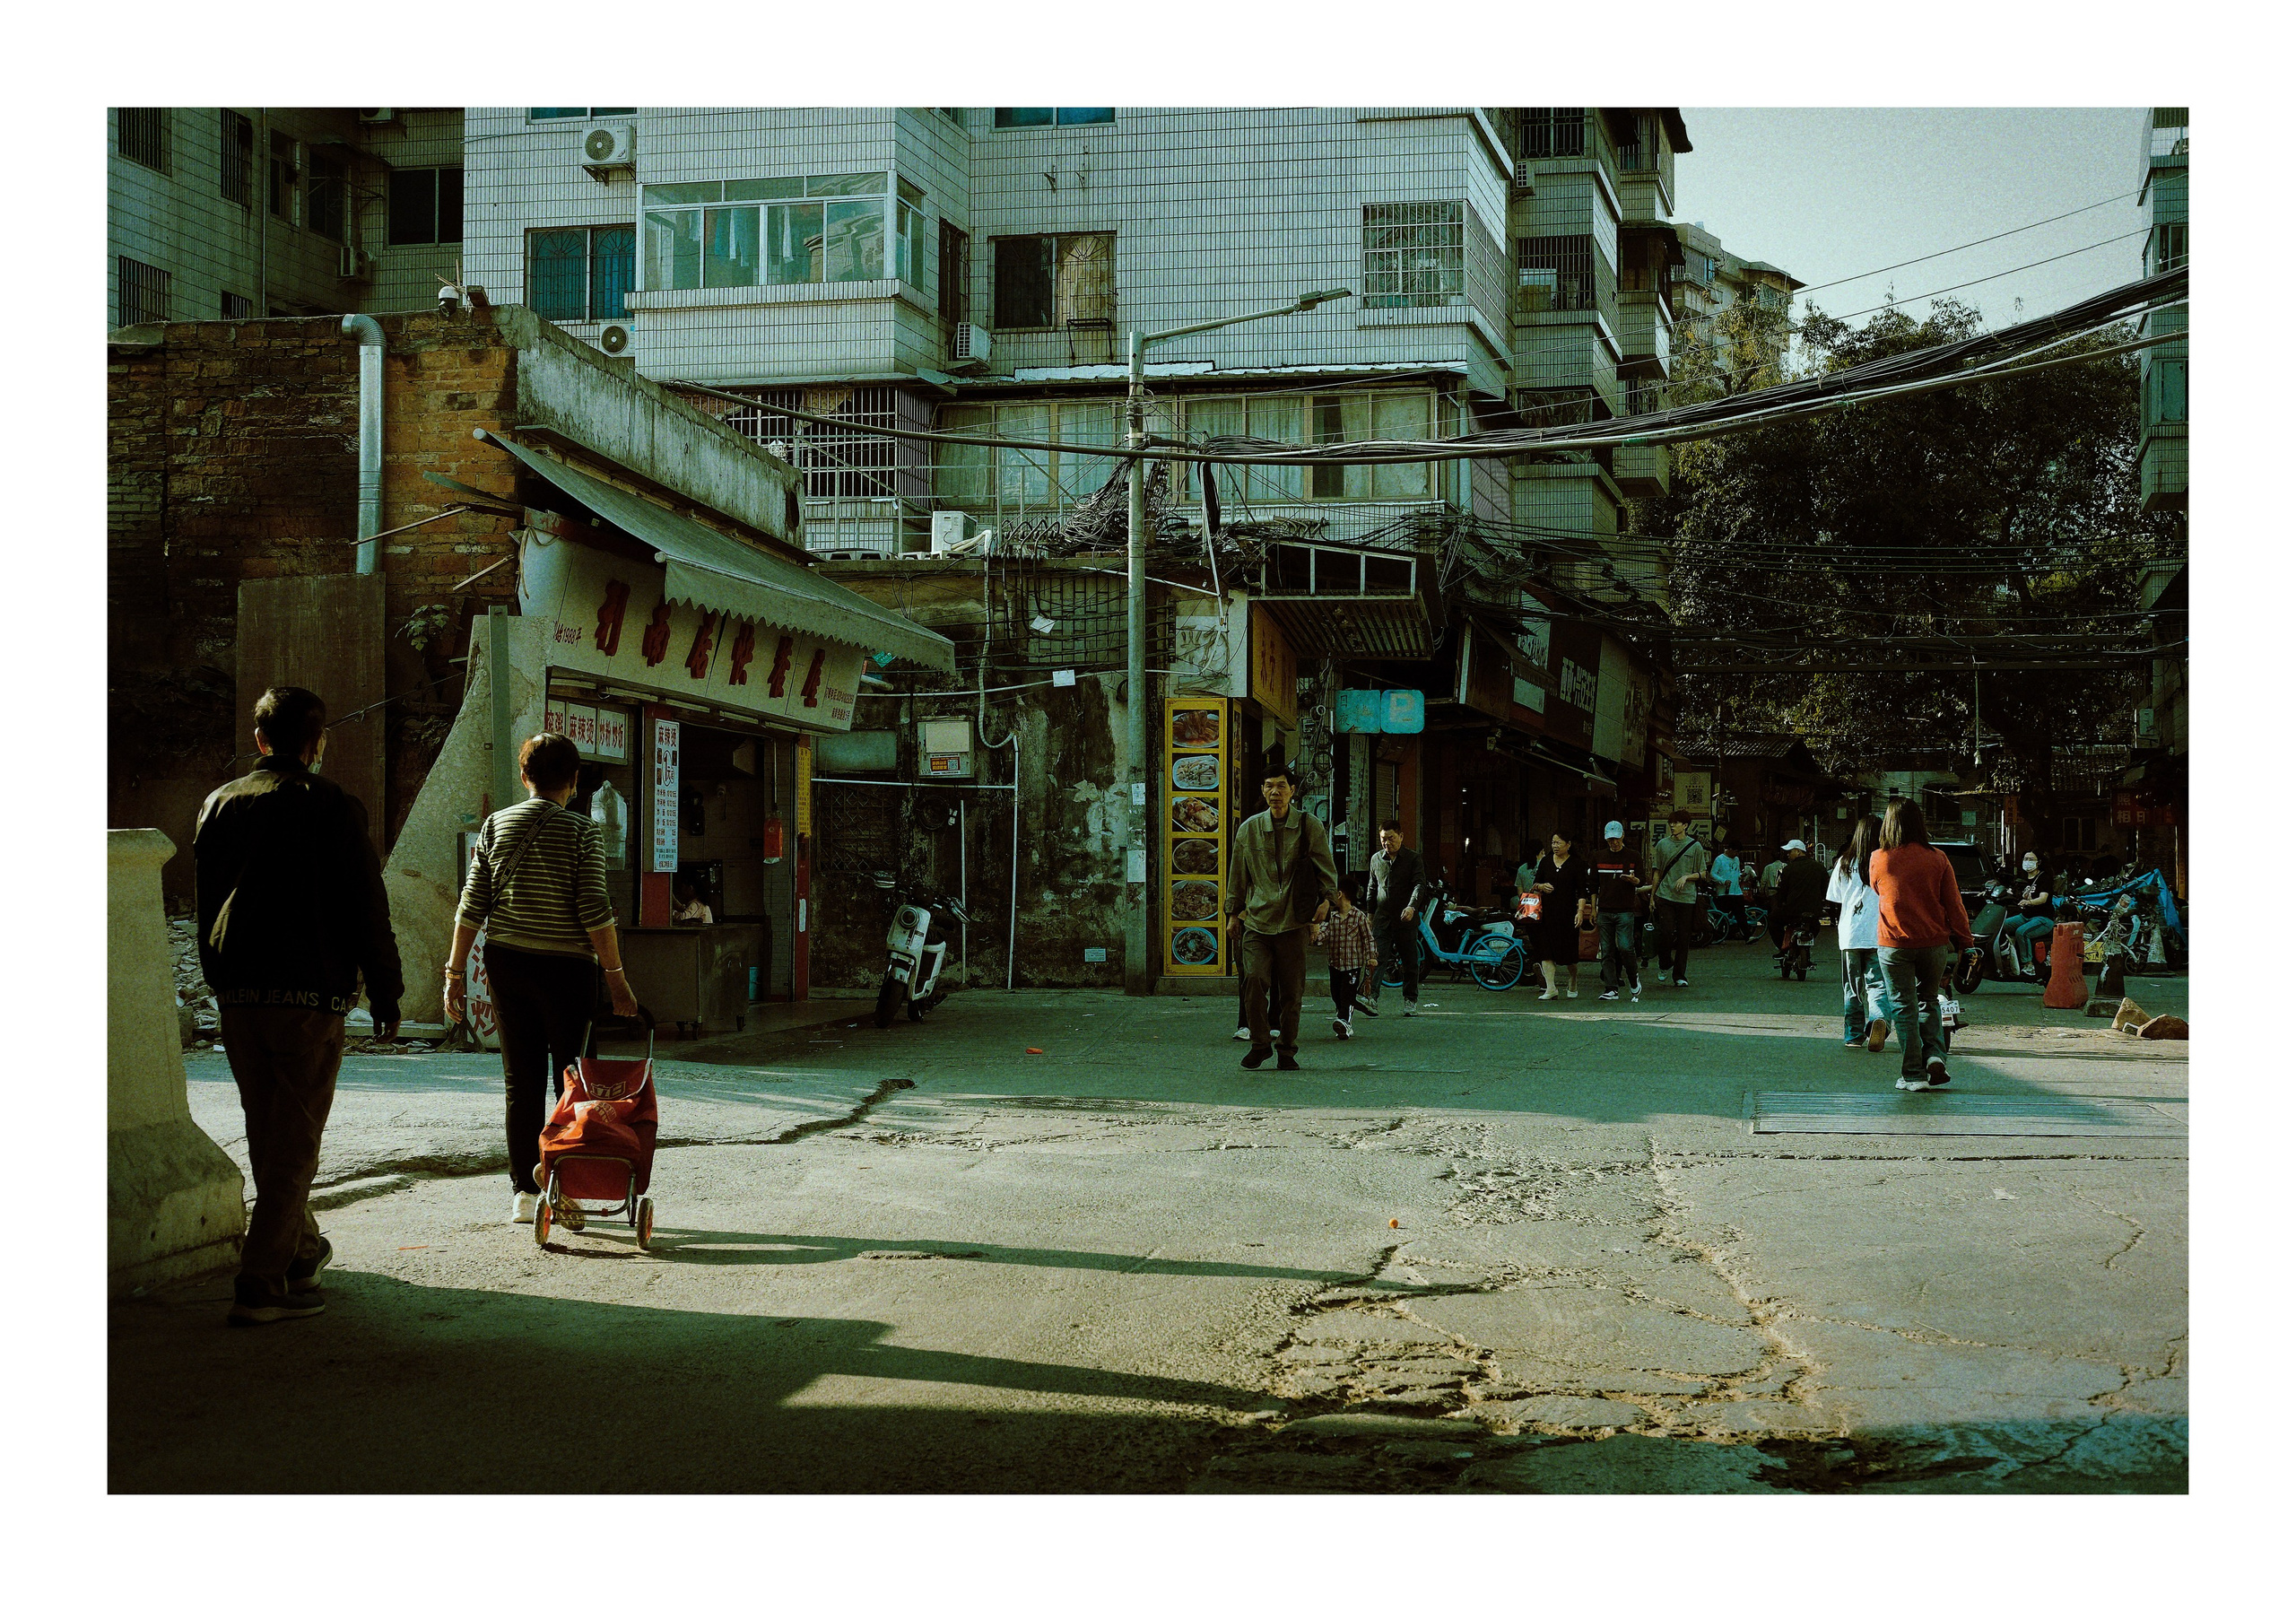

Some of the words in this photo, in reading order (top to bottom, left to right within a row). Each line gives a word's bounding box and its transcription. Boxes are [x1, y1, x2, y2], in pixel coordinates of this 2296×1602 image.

[1389, 692, 1414, 723] P
[570, 713, 594, 744] 麻辣烫
[658, 725, 676, 747] 麻辣烫
[226, 988, 259, 1005] KLEIN
[264, 988, 319, 1006] JEANS
[331, 996, 347, 1014] CA
